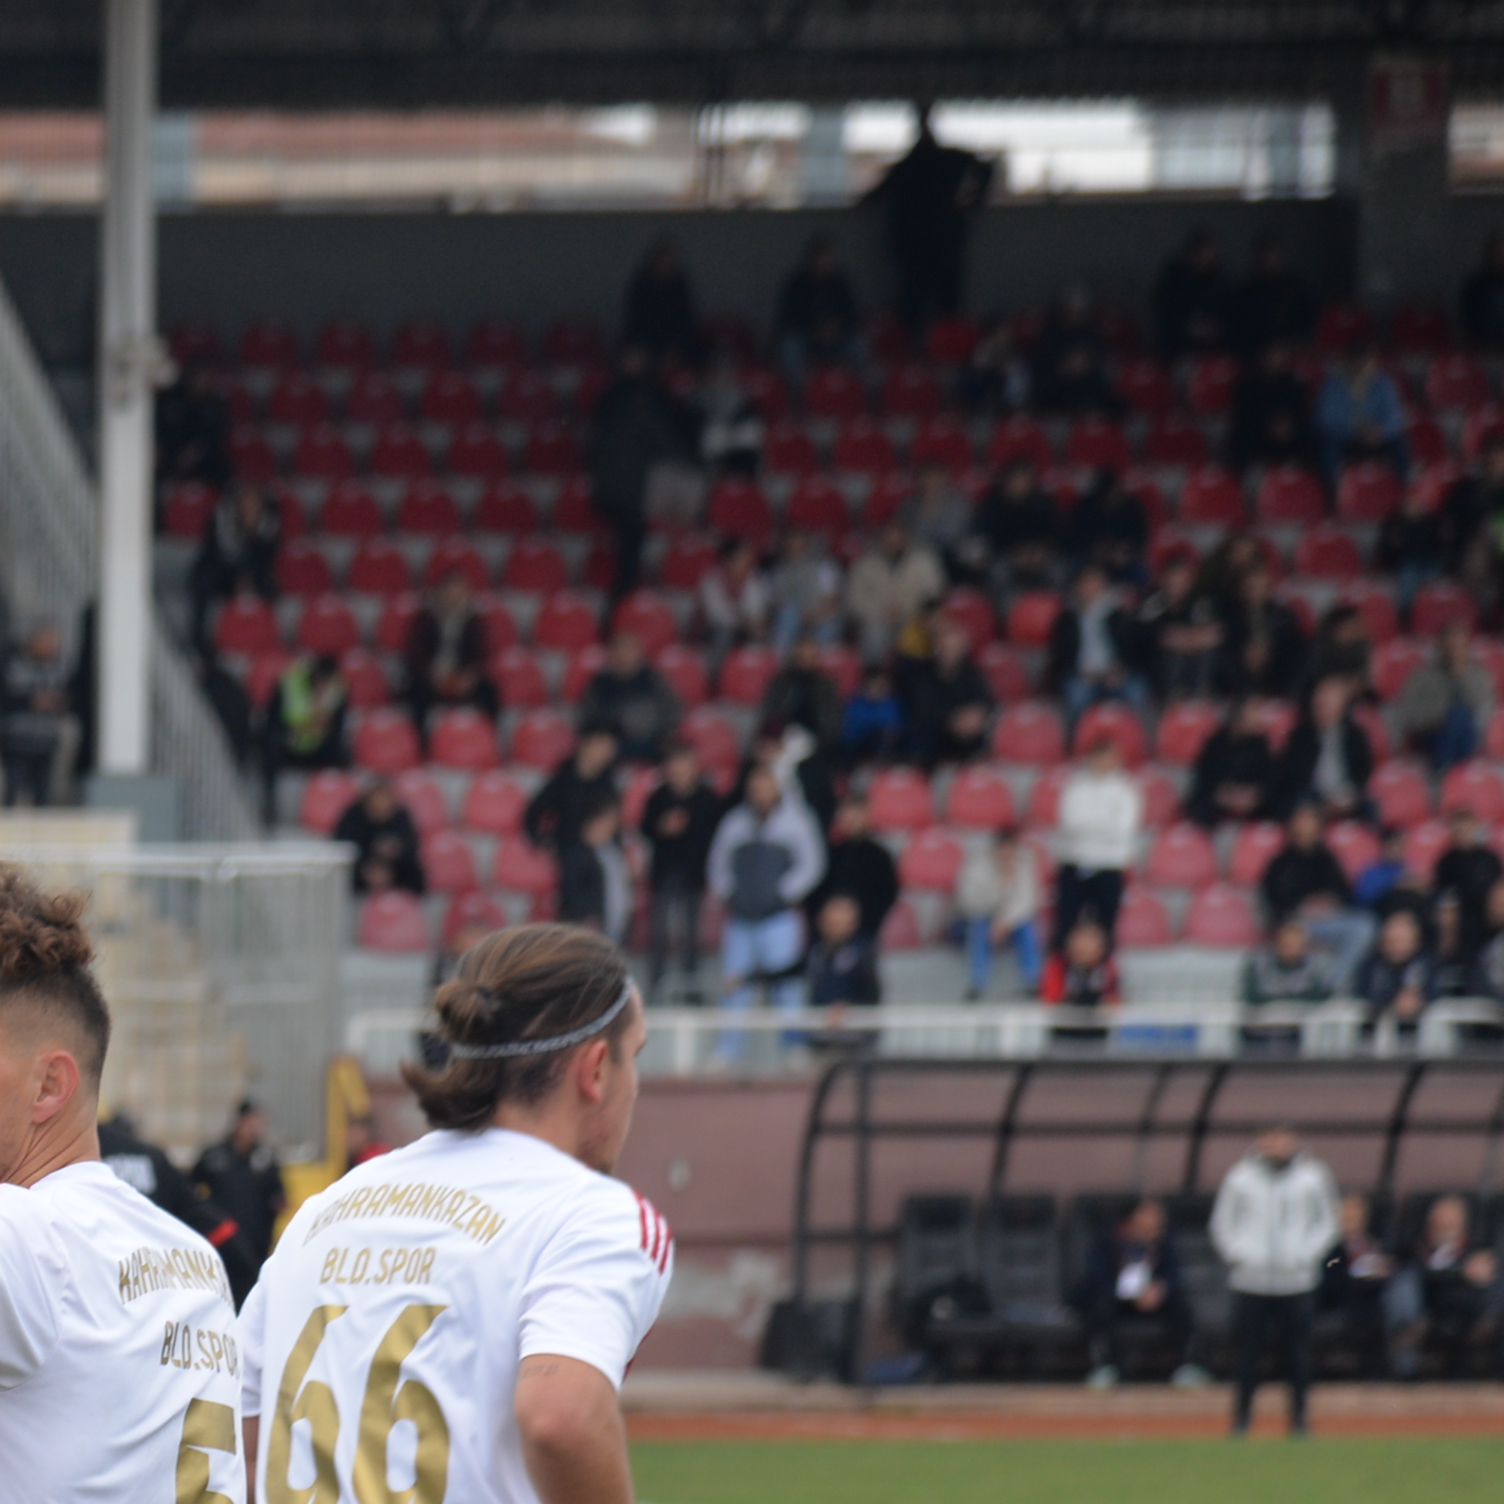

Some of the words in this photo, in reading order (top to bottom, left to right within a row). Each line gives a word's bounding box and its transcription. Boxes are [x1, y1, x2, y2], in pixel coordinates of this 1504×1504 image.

[301, 1183, 506, 1247] KAHRAMANKAZAN
[319, 1247, 437, 1285] BLD.SPOR
[160, 1320, 241, 1379] BLD.SPO
